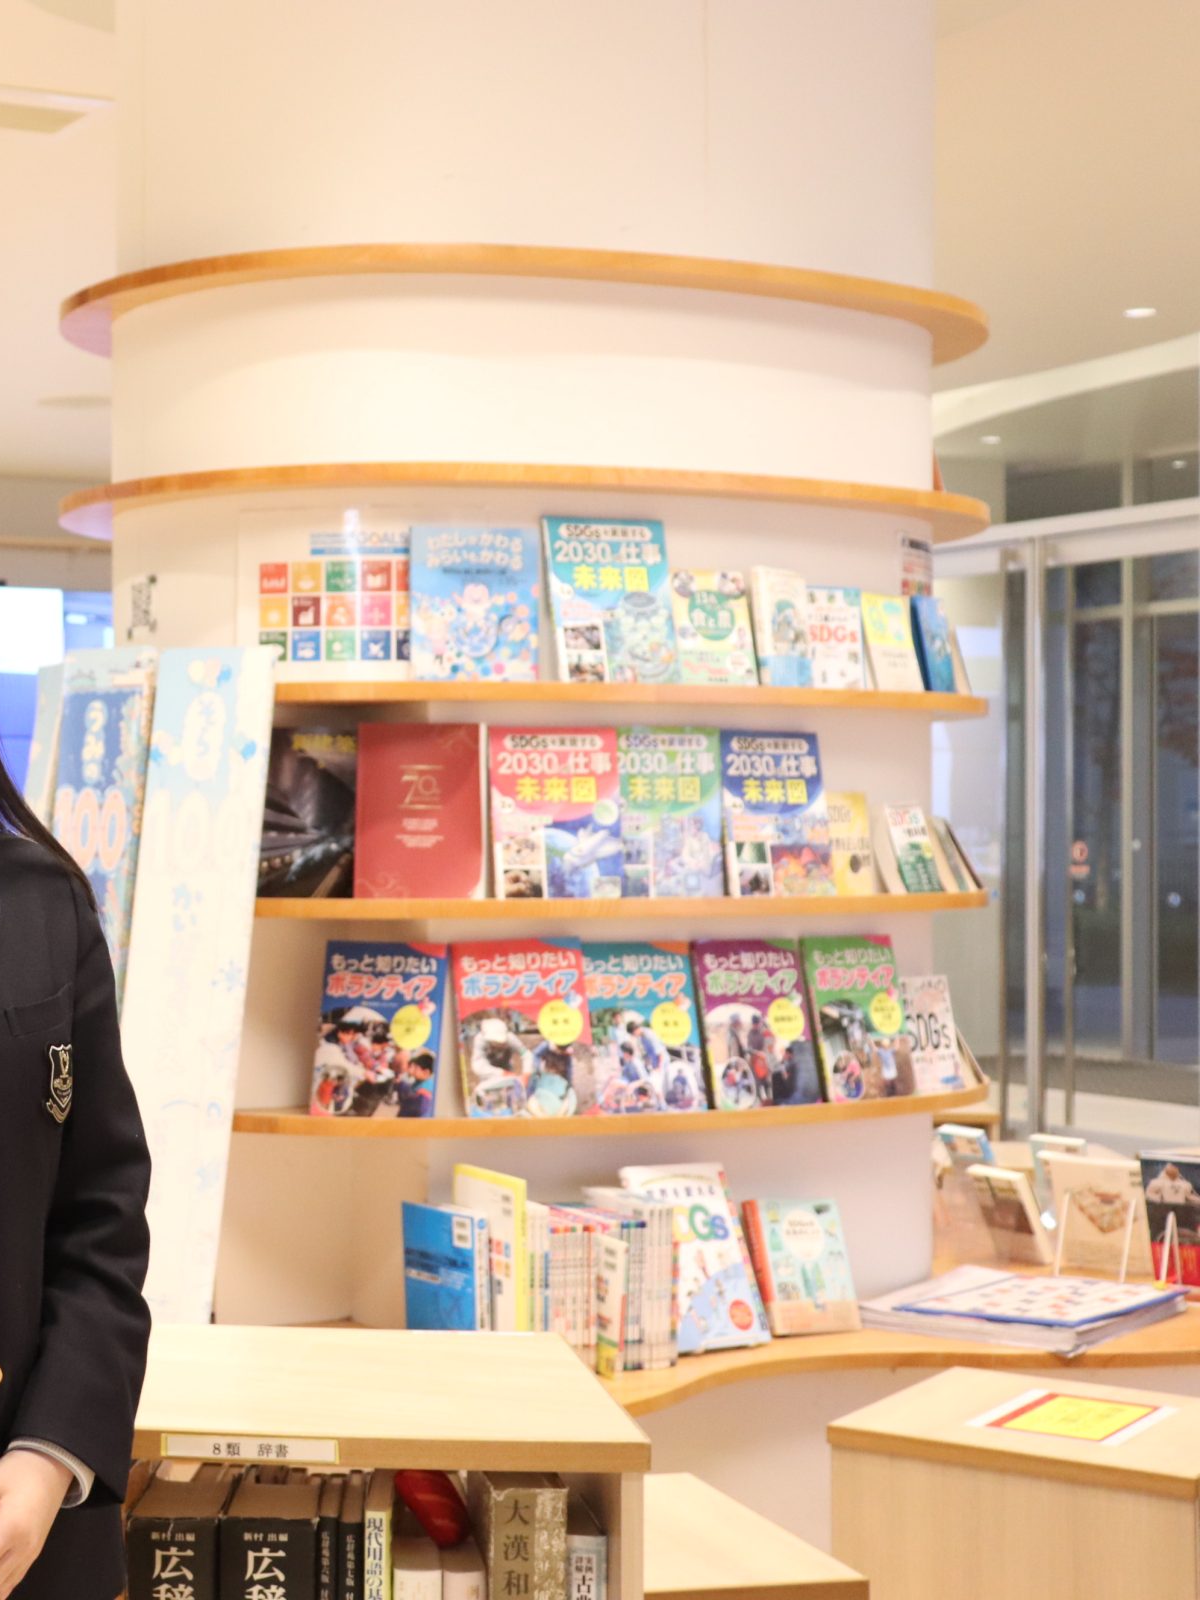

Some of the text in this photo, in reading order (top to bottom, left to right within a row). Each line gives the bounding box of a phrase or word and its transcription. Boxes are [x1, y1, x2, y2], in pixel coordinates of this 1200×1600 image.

[809, 624, 858, 643] SDGs
[515, 775, 598, 804] 未来図
[331, 953, 437, 974] もっと知りたい
[461, 950, 576, 974] もっと知りたい
[583, 953, 685, 974] もっと知りたい
[704, 950, 794, 969] もっと知りたい
[812, 947, 894, 967] もっと知りたい
[327, 972, 437, 999] ボランティア
[463, 970, 577, 998] ボランティア
[584, 971, 686, 998] ボランティア
[706, 967, 798, 995] ボランティア
[815, 964, 895, 990] ボランティア
[905, 1011, 952, 1052] SDGs
[257, 1443, 289, 1459] 辞書
[502, 1499, 530, 1596] 大漢和
